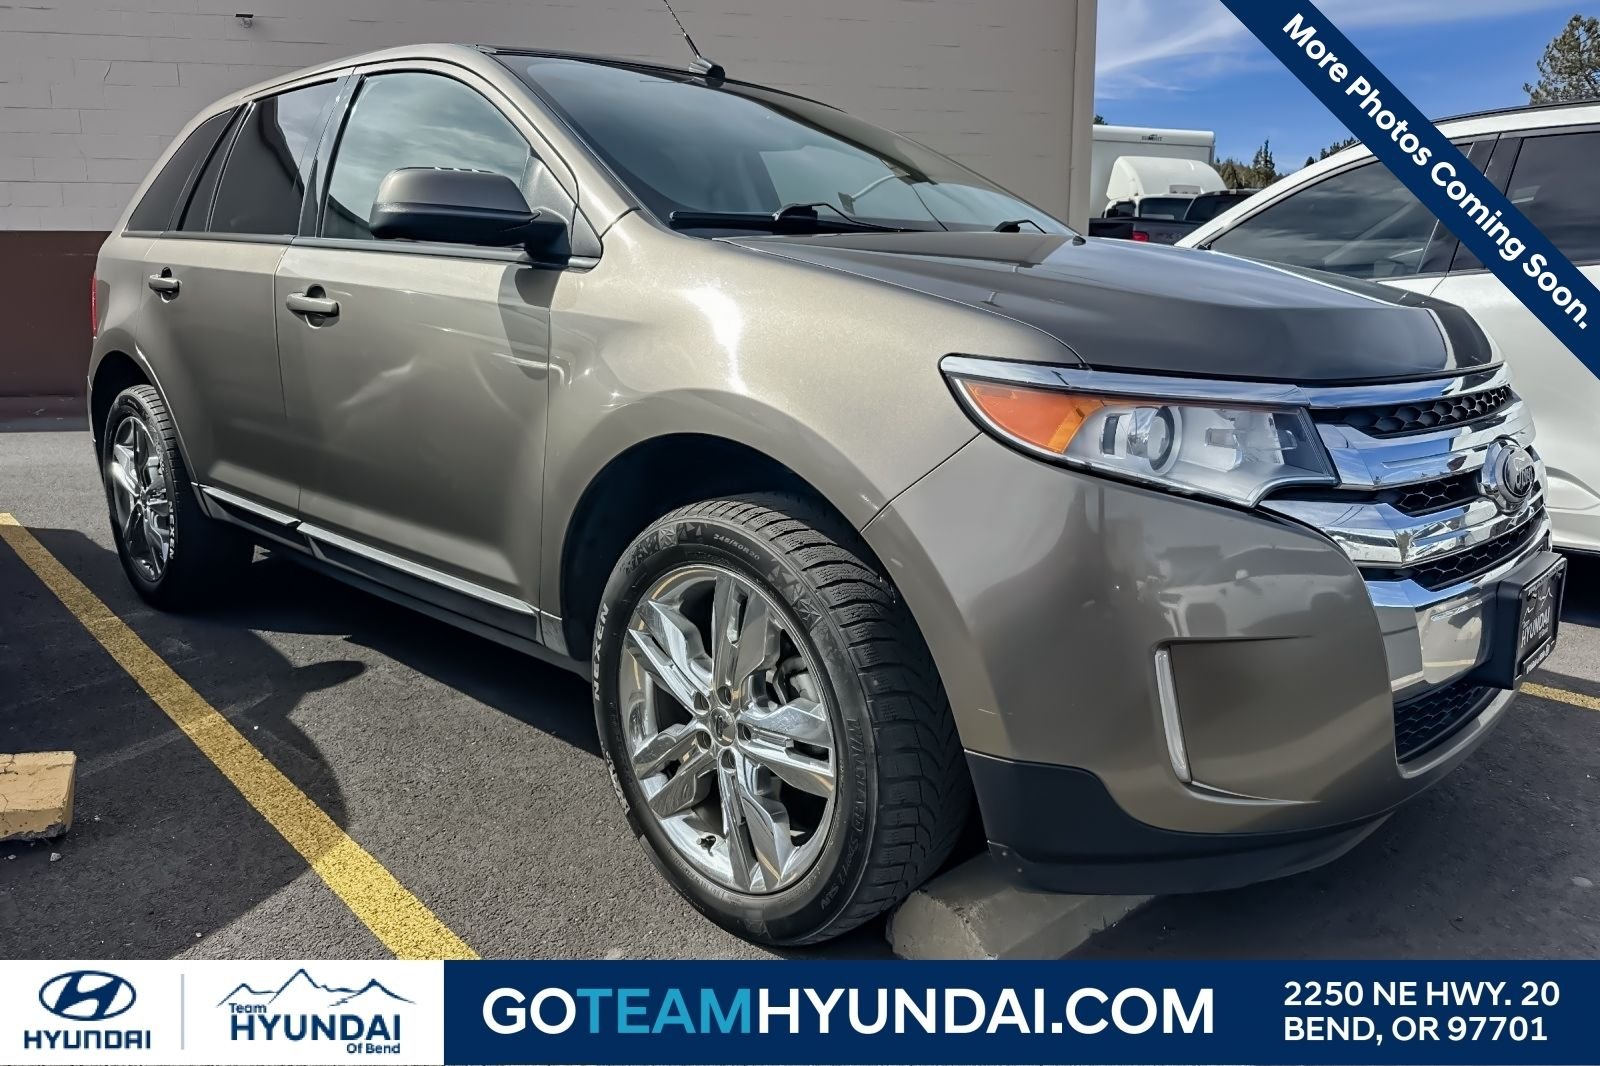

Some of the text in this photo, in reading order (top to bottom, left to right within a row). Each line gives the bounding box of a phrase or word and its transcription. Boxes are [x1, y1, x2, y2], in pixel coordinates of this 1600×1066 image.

[168, 500, 176, 560] NEXEN
[593, 602, 610, 702] NEXEN
[1520, 605, 1551, 649] HYUNDAI
